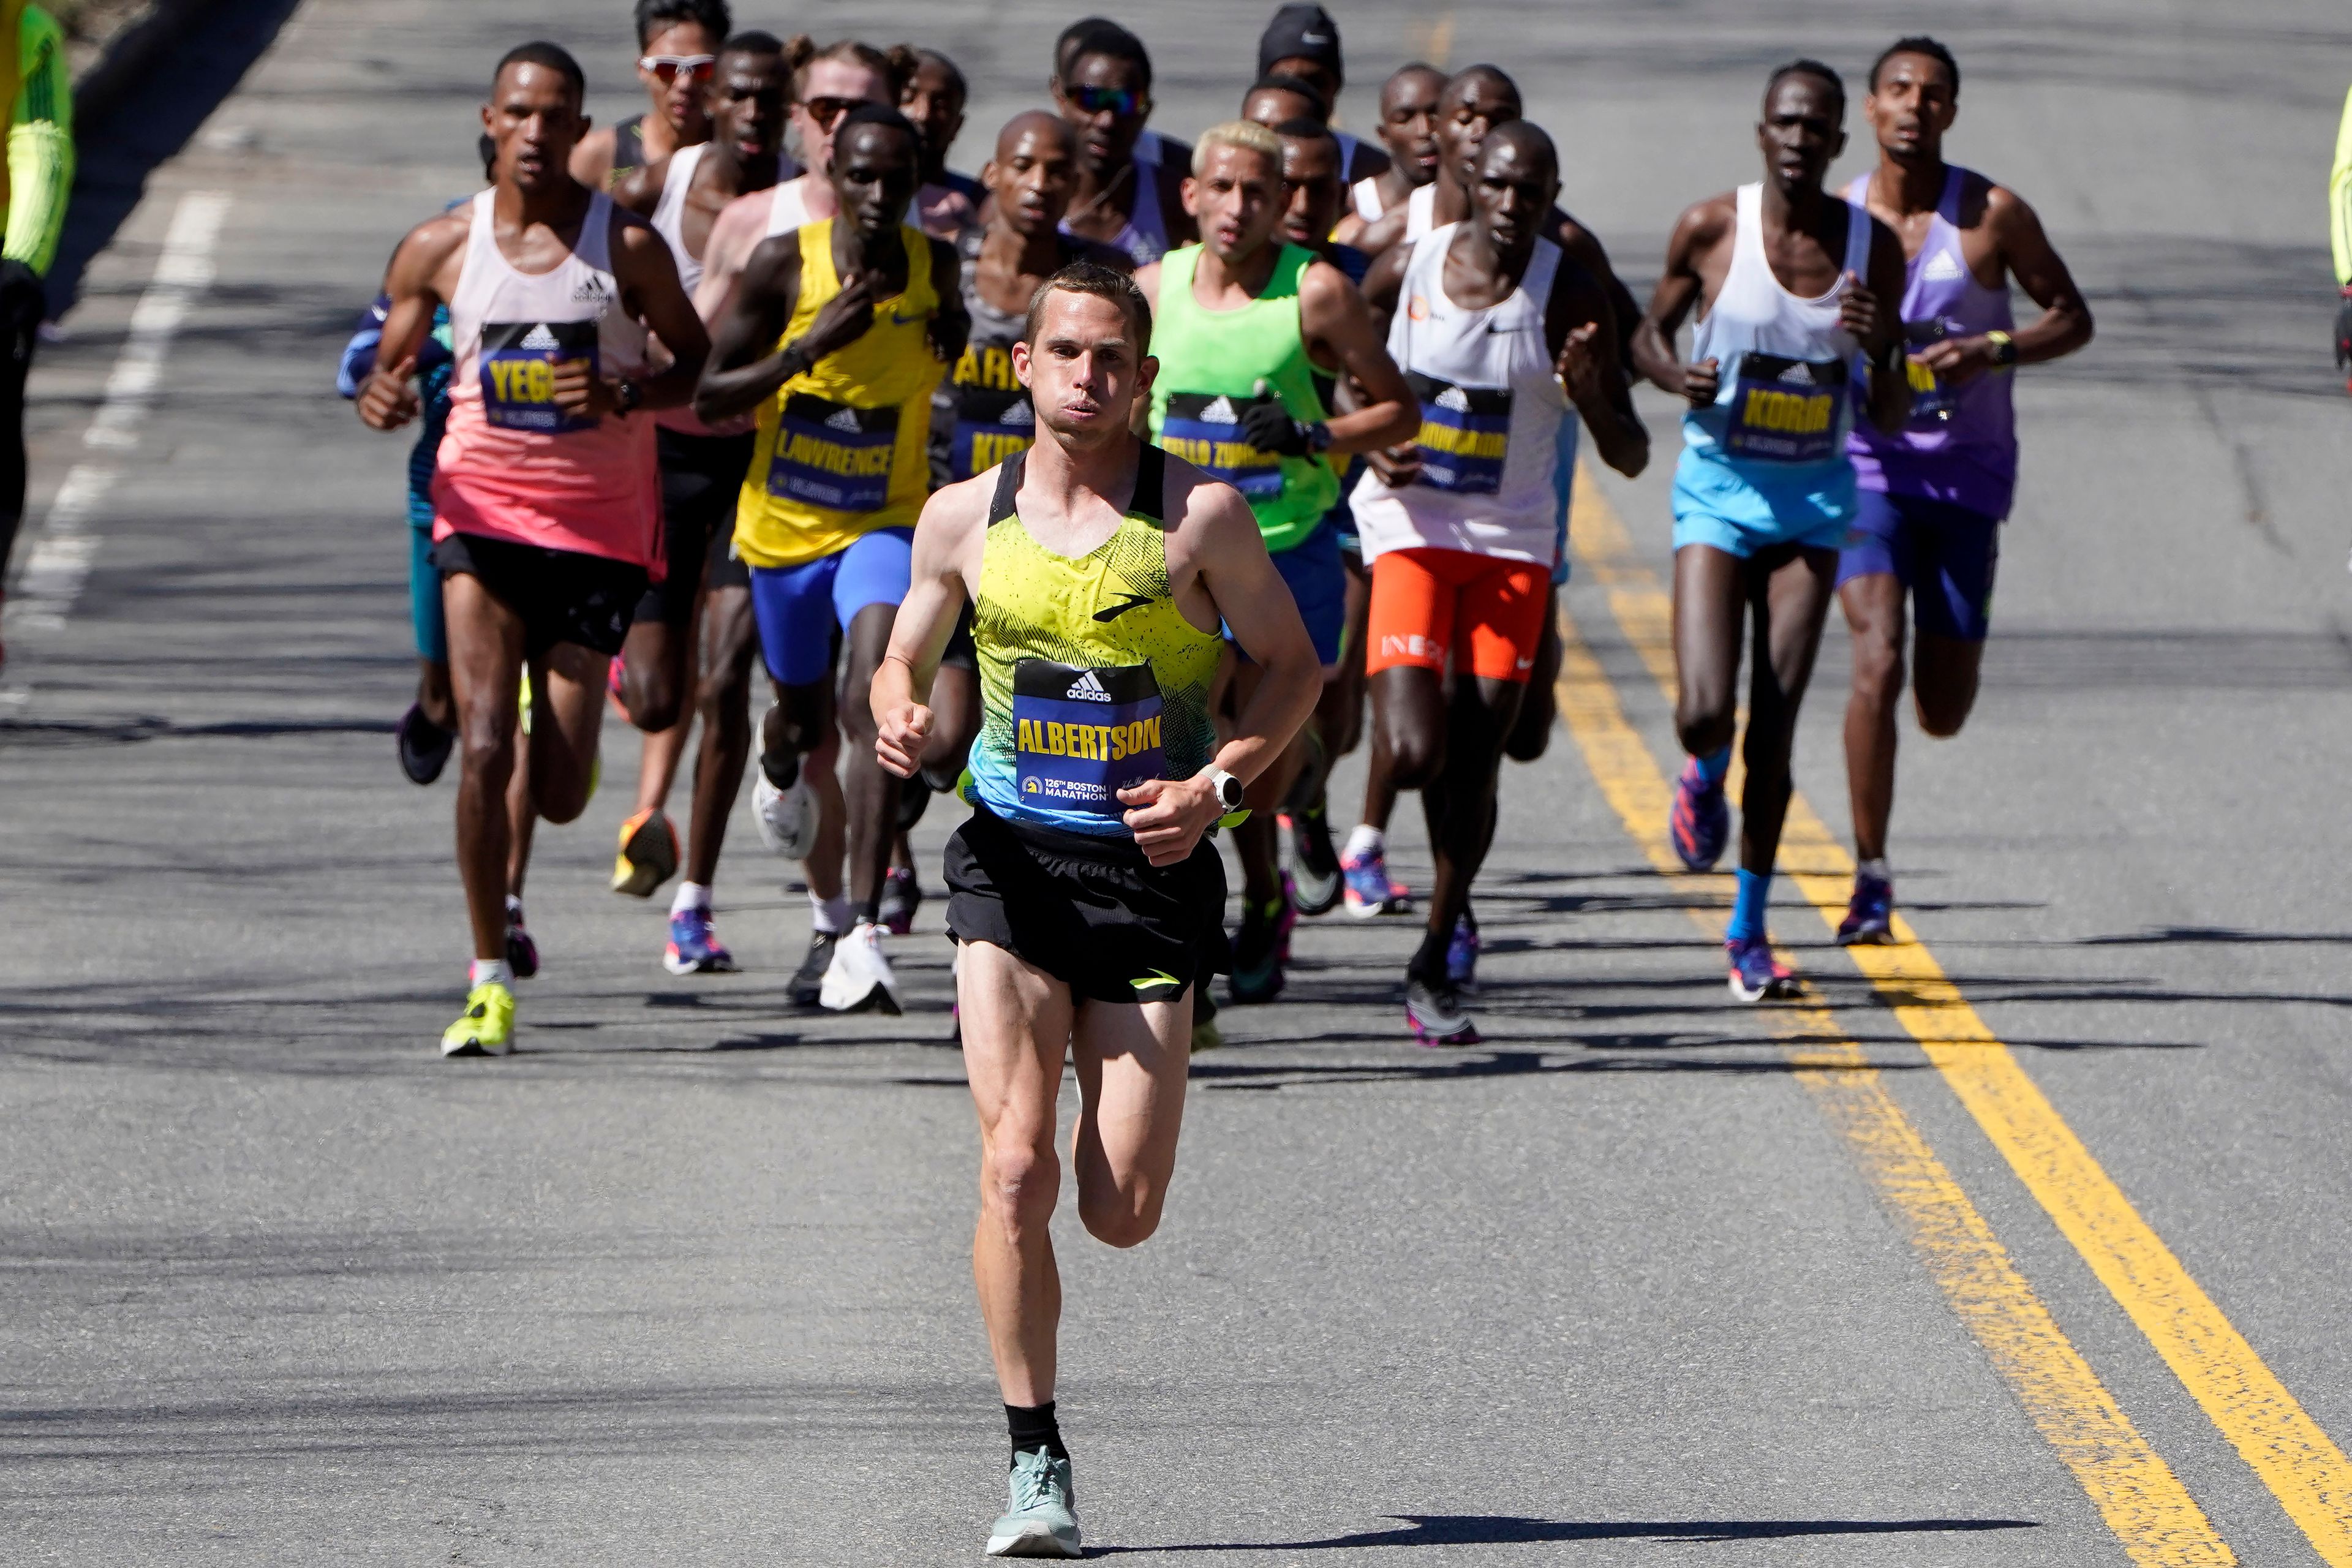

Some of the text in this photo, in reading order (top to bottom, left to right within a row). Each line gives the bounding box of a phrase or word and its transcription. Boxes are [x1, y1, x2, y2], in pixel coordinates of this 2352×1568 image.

[1744, 388, 1833, 434] KORIR
[775, 428, 894, 477] LAWRENCE
[1066, 688, 1112, 702] adidas
[1018, 715, 1161, 762] ALBERTSON
[1045, 787, 1107, 801] MARATHON
[1067, 782, 1107, 793] BOSTON
